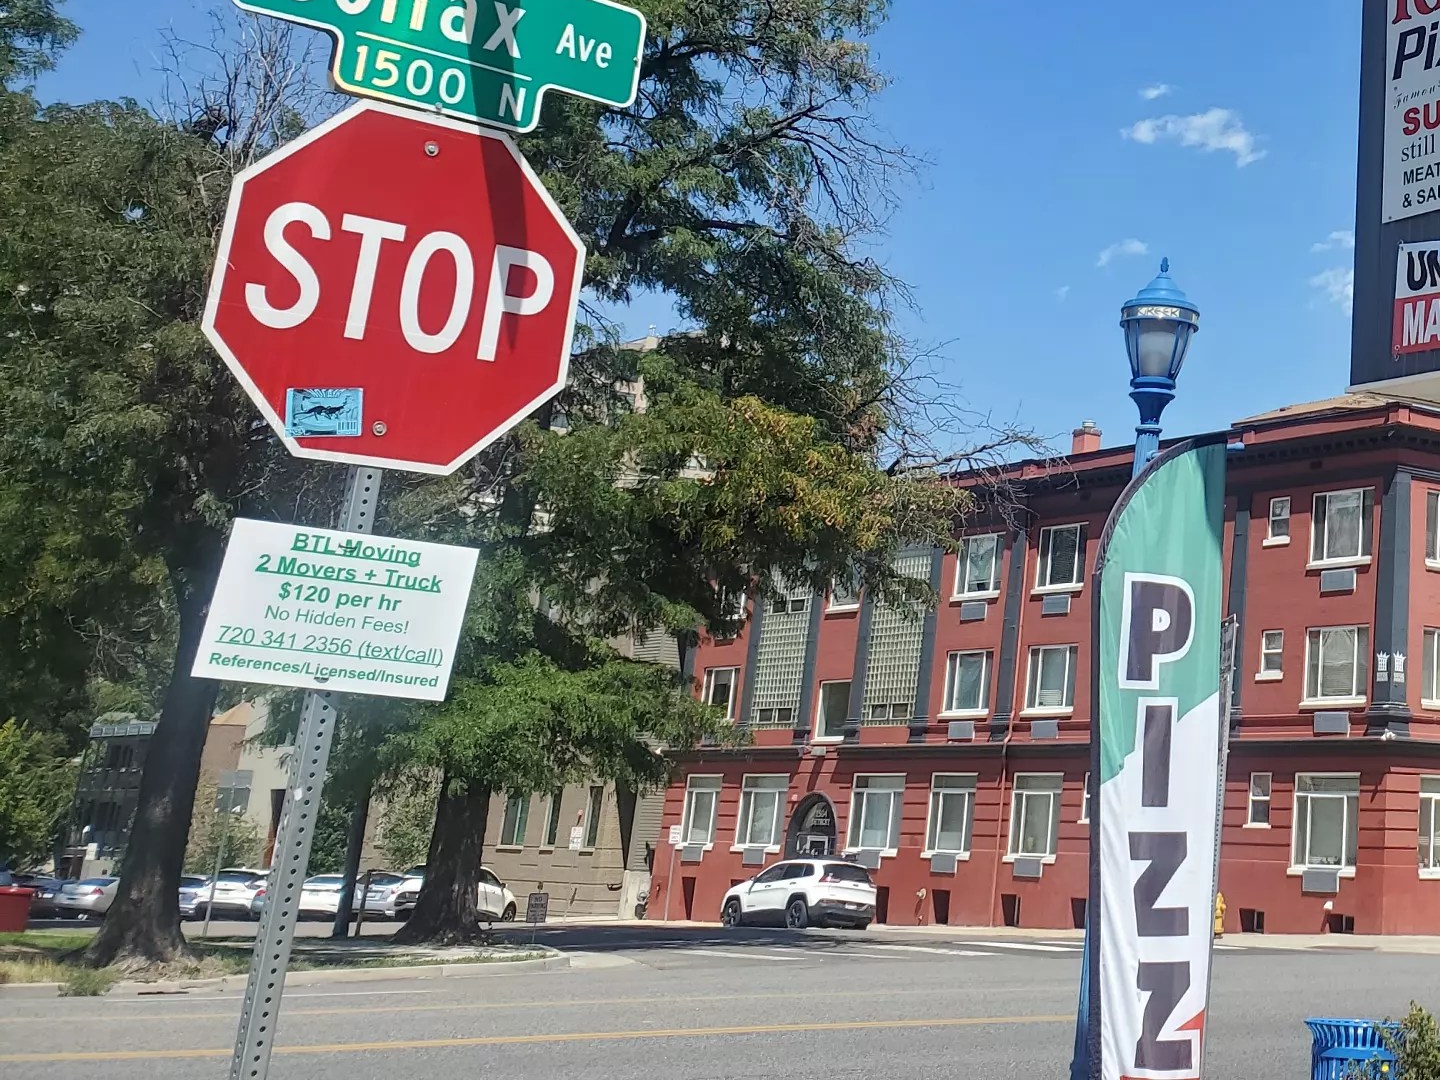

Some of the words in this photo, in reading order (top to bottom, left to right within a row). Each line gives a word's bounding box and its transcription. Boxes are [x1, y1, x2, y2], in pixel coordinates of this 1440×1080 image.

[556, 23, 613, 69] Ave
[352, 45, 466, 106] 1500
[500, 86, 527, 122] N
[1400, 132, 1436, 163] still
[1402, 192, 1412, 209] &
[244, 201, 555, 362] STOP
[291, 532, 336, 554] BTL
[344, 539, 421, 567] Moving
[257, 554, 271, 572] 2
[277, 556, 357, 582] Movers
[365, 570, 377, 581] +
[385, 569, 442, 592] Truck
[278, 581, 330, 604] $120
[335, 591, 373, 610] per
[378, 594, 402, 611] hr
[264, 605, 290, 622] No
[295, 608, 358, 629] Hidden
[361, 617, 409, 634] Fees!
[218, 625, 255, 645] 720
[261, 629, 296, 649] 341
[303, 634, 352, 655] 2356
[358, 640, 443, 668] (text/call)
[208, 652, 439, 688] References/Licensed/Insured
